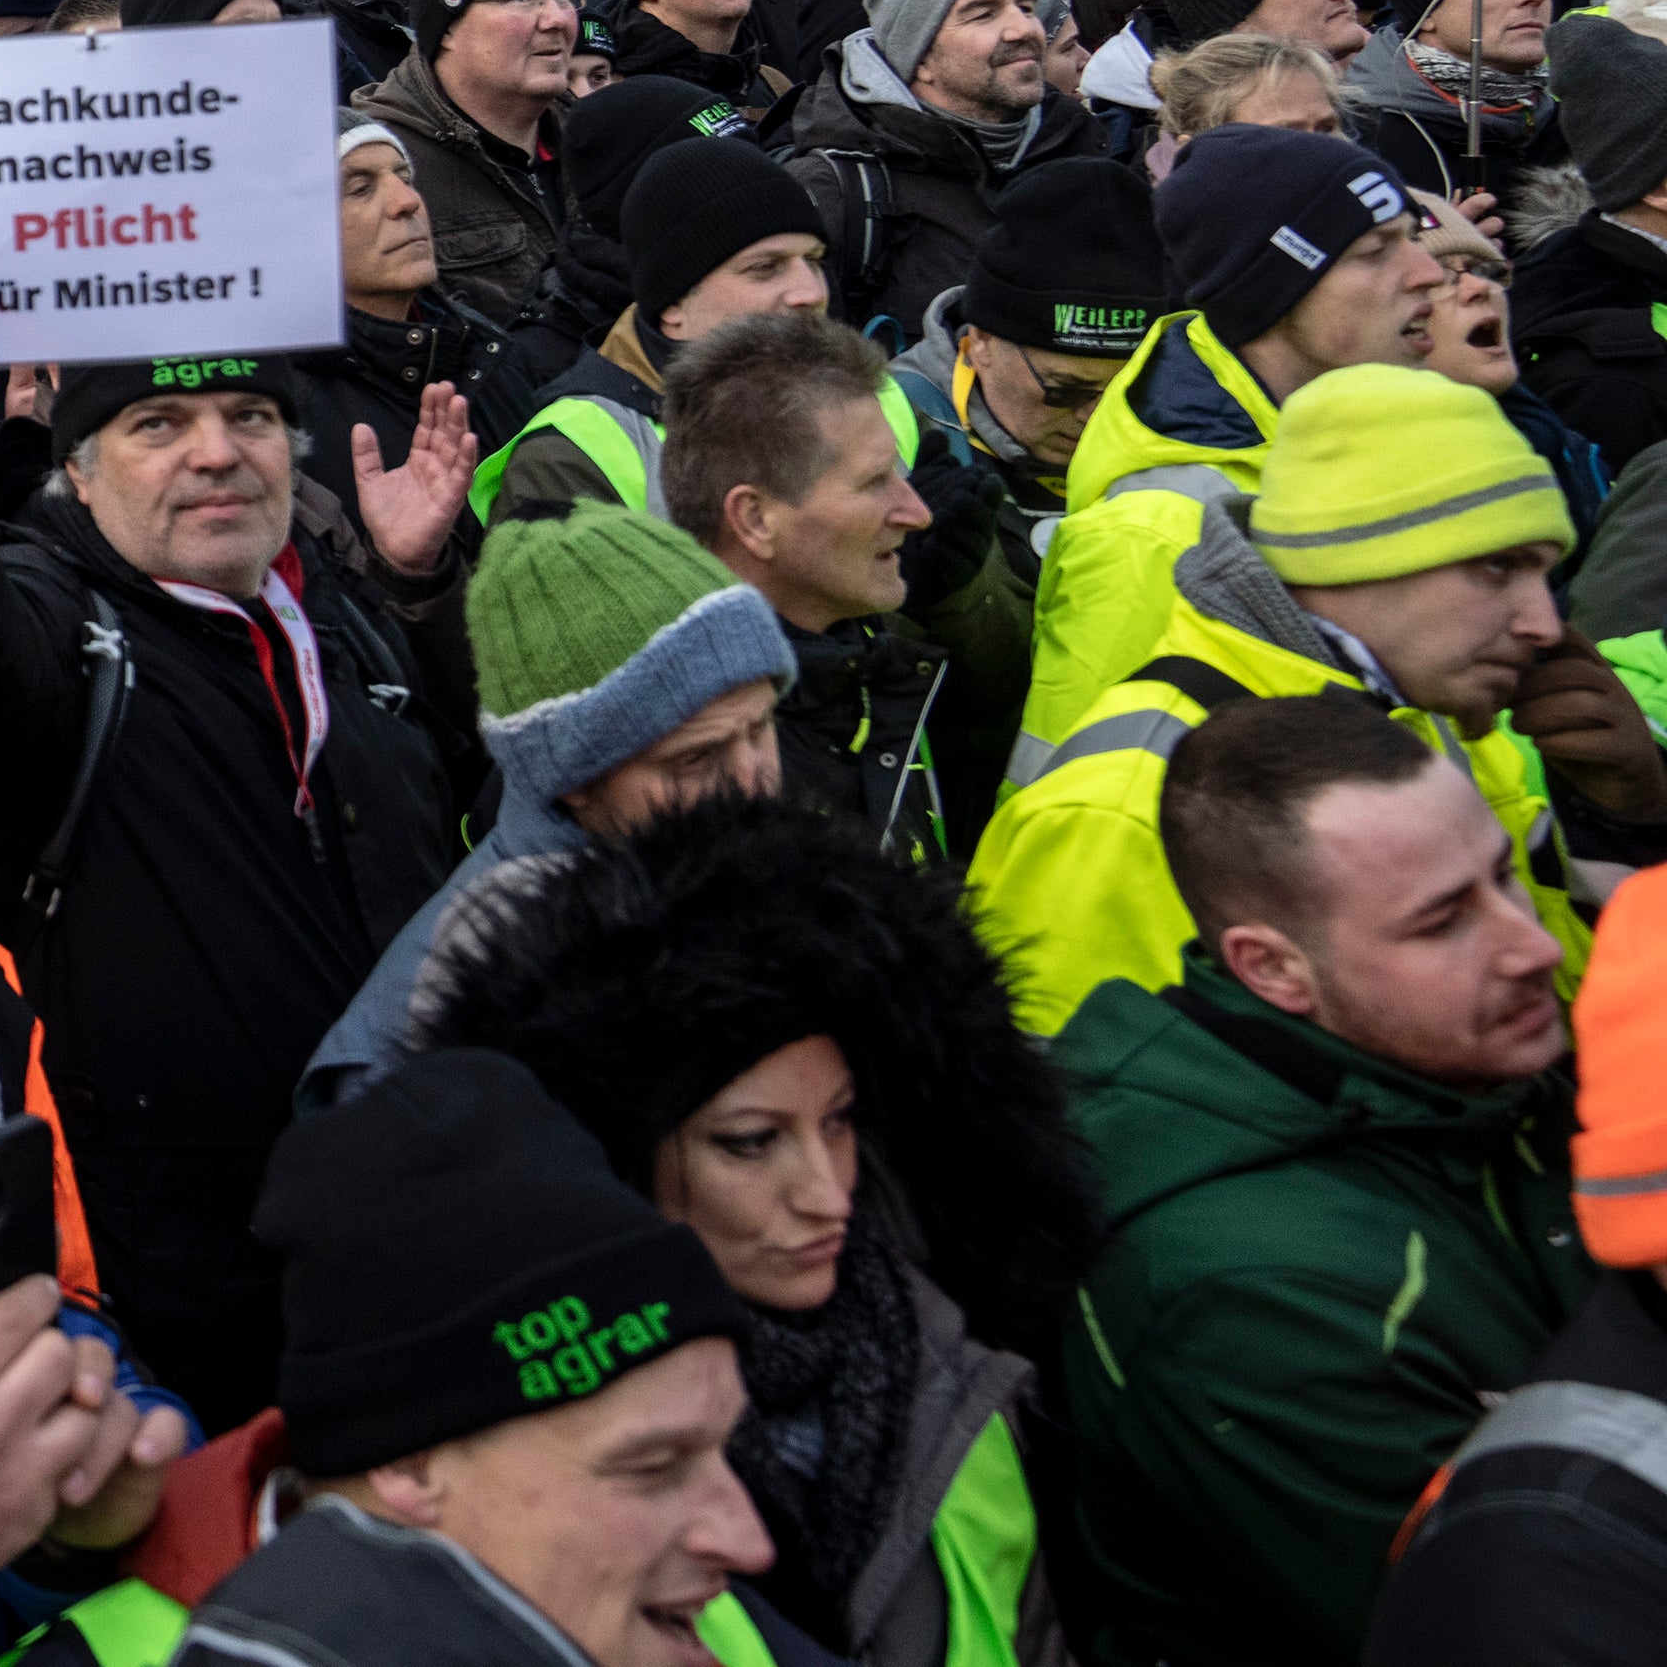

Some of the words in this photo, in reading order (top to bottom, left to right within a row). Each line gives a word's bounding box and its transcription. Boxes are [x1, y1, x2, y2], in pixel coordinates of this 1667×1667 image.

[11, 202, 199, 253] Pflicht
[52, 270, 236, 311] Minister
[248, 266, 264, 299] !
[1054, 304, 1147, 335] WEILEPP
[151, 357, 260, 389] agrar
[492, 1294, 592, 1361] top
[519, 1301, 669, 1402] agrar
